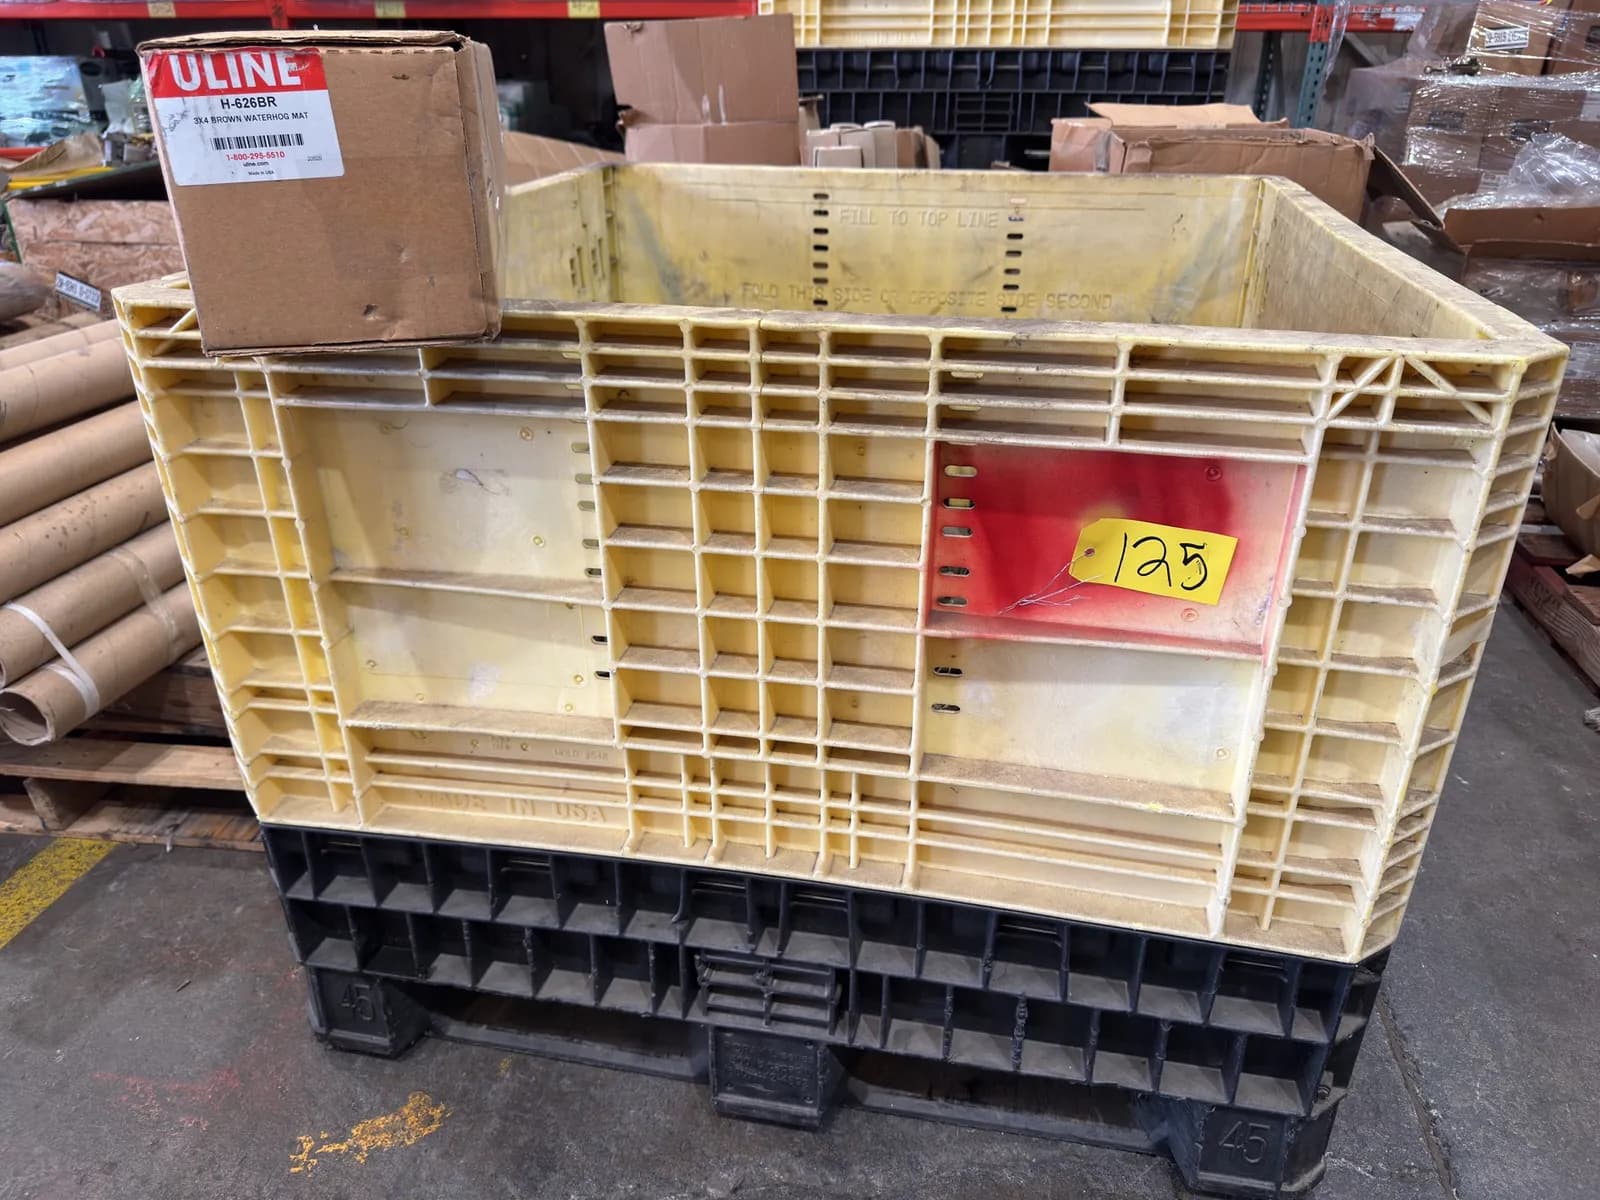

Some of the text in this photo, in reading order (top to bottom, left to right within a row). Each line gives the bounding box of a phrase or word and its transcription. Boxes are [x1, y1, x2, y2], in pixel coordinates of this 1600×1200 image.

[169, 52, 301, 91] ULINE
[220, 96, 278, 110] H-626BR
[193, 117, 209, 125] 3X4
[211, 115, 242, 124] BROWN
[243, 112, 290, 122] WATERHOG
[226, 151, 285, 161] 1-800-295-5510
[840, 208, 999, 229] FILL TO TOP LINE
[742, 282, 778, 299] FOLD
[1044, 294, 1112, 310] SECOND
[1114, 532, 1208, 591] 125
[552, 802, 607, 823] USA
[1218, 1121, 1269, 1163] 45
